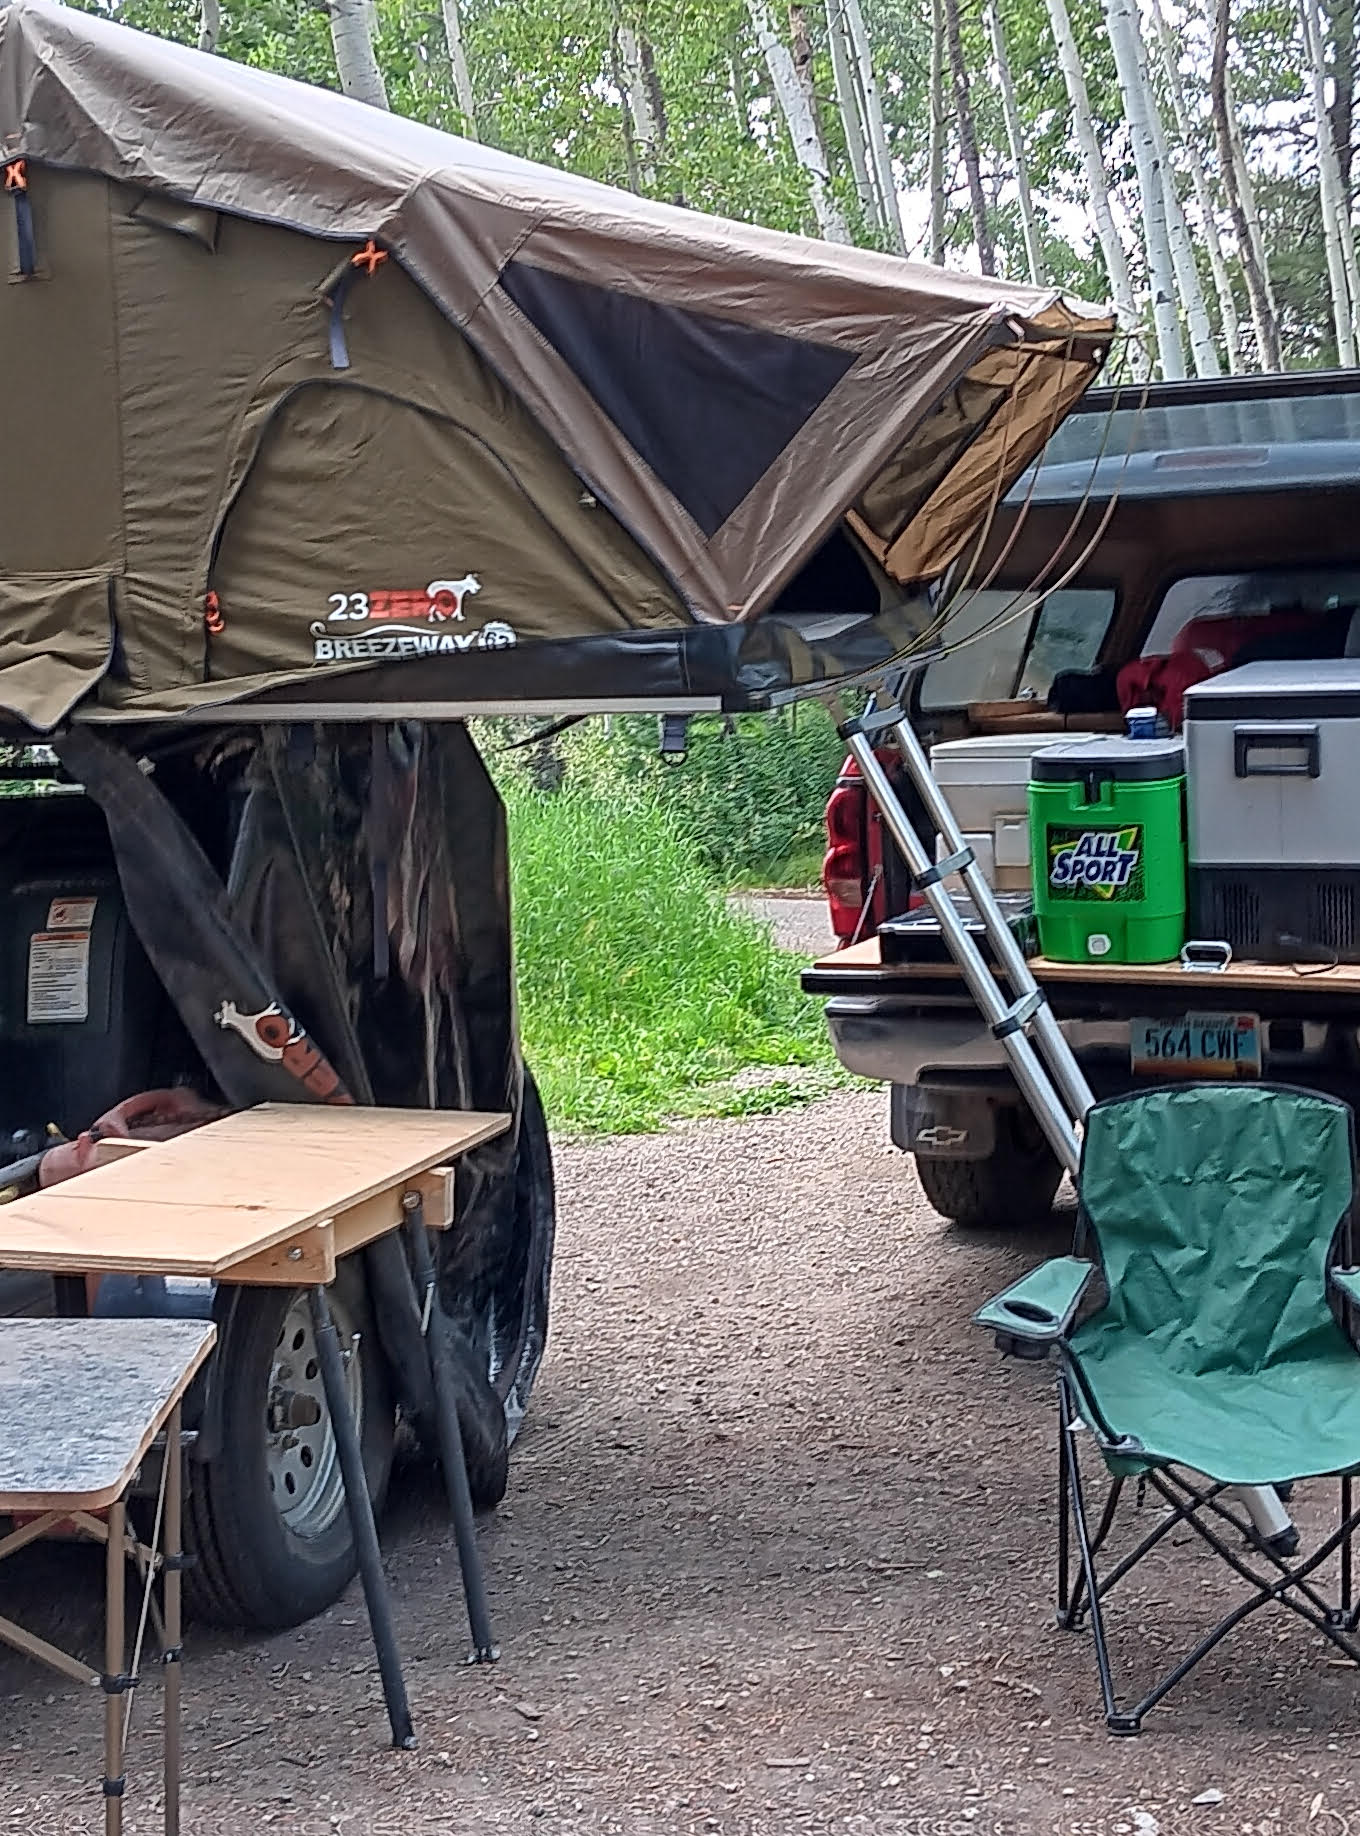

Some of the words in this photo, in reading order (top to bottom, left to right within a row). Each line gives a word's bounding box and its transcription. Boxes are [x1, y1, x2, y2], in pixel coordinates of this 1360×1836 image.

[314, 631, 479, 661] BREEZEWAY
[1073, 833, 1120, 858] ALL
[1052, 851, 1137, 883] SPORT
[1144, 1028, 1191, 1058] 564
